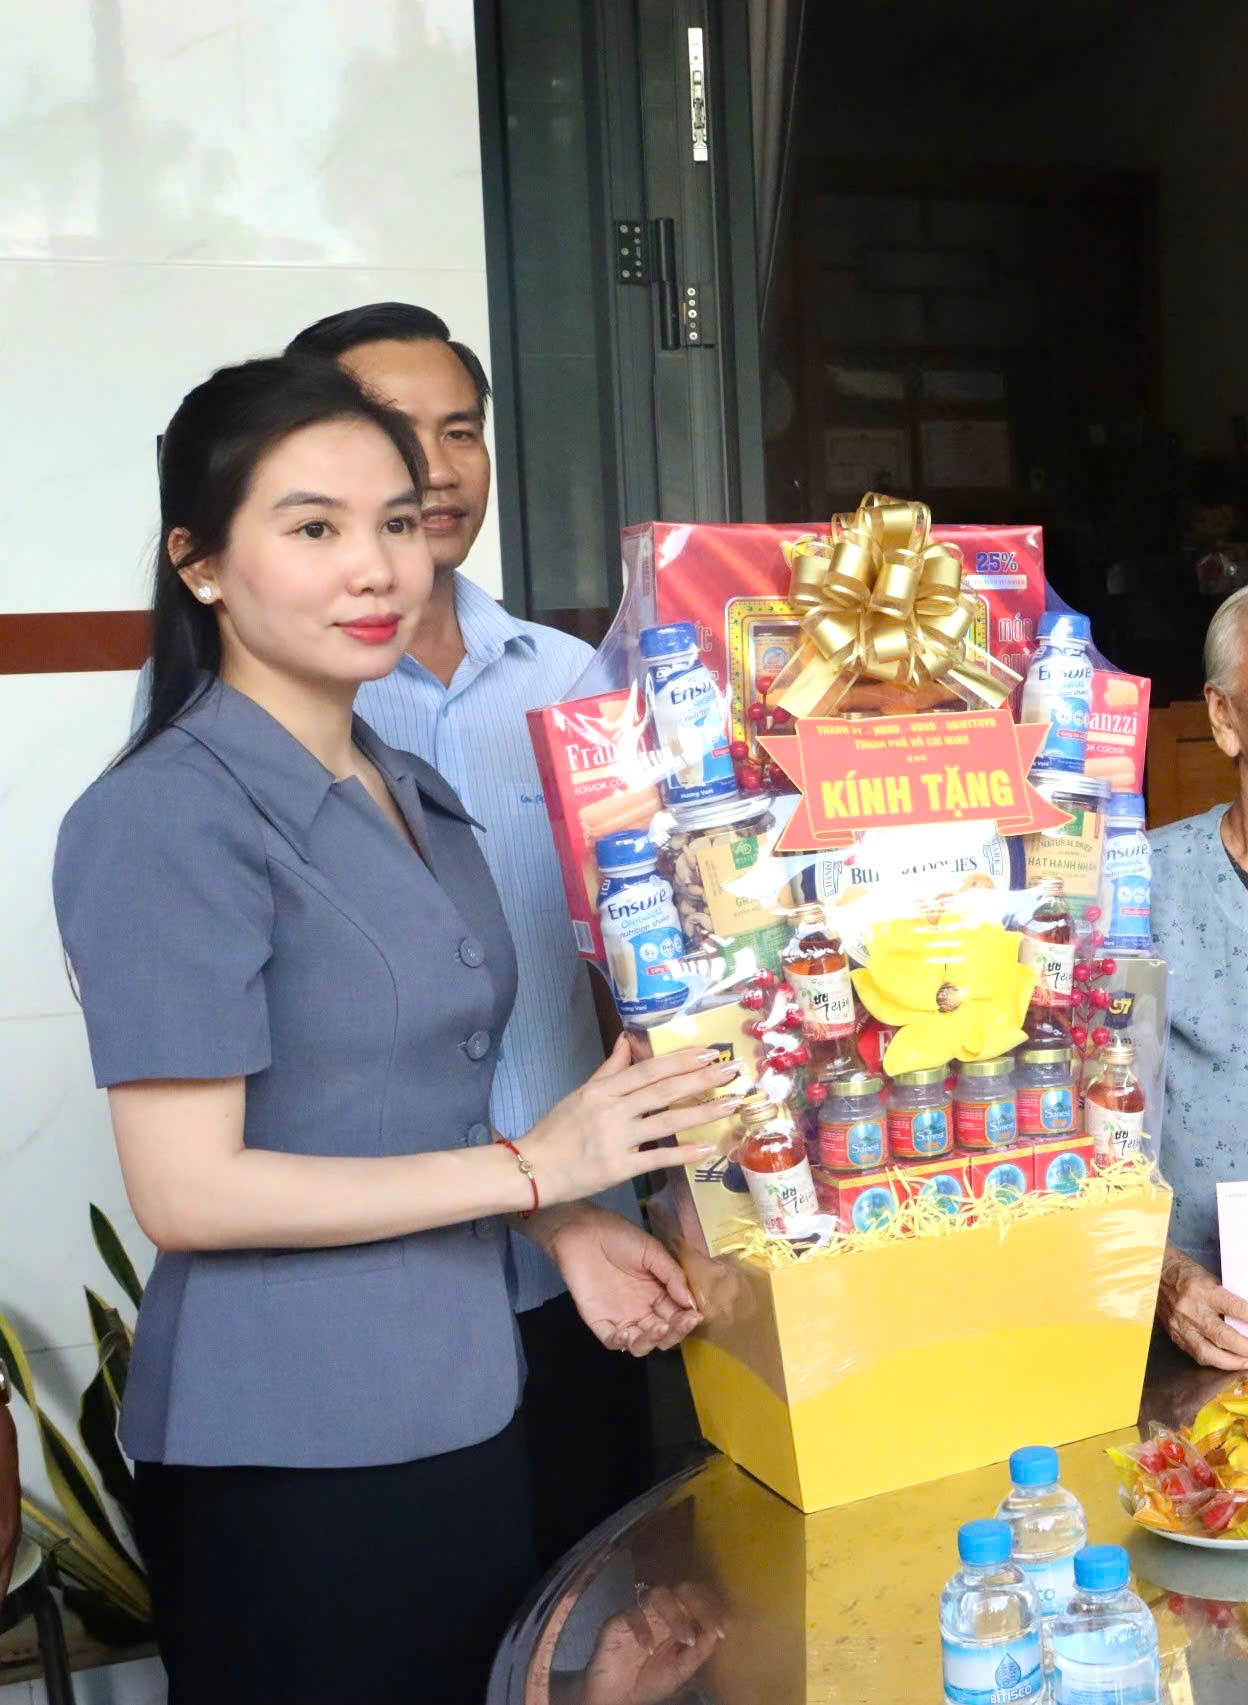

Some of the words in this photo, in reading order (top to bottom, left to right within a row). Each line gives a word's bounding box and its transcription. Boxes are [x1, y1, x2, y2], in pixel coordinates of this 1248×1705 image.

[976, 552, 1018, 572] 25%
[670, 681, 712, 706] Ensu
[1089, 712, 1138, 735] anzzi
[565, 743, 618, 771] Fran
[820, 770, 913, 819] KÍNH
[921, 765, 1015, 818] TẶNG
[1107, 843, 1149, 860] nsure
[607, 889, 666, 920] Ensure
[990, 1685, 1032, 1704] BITISCO
